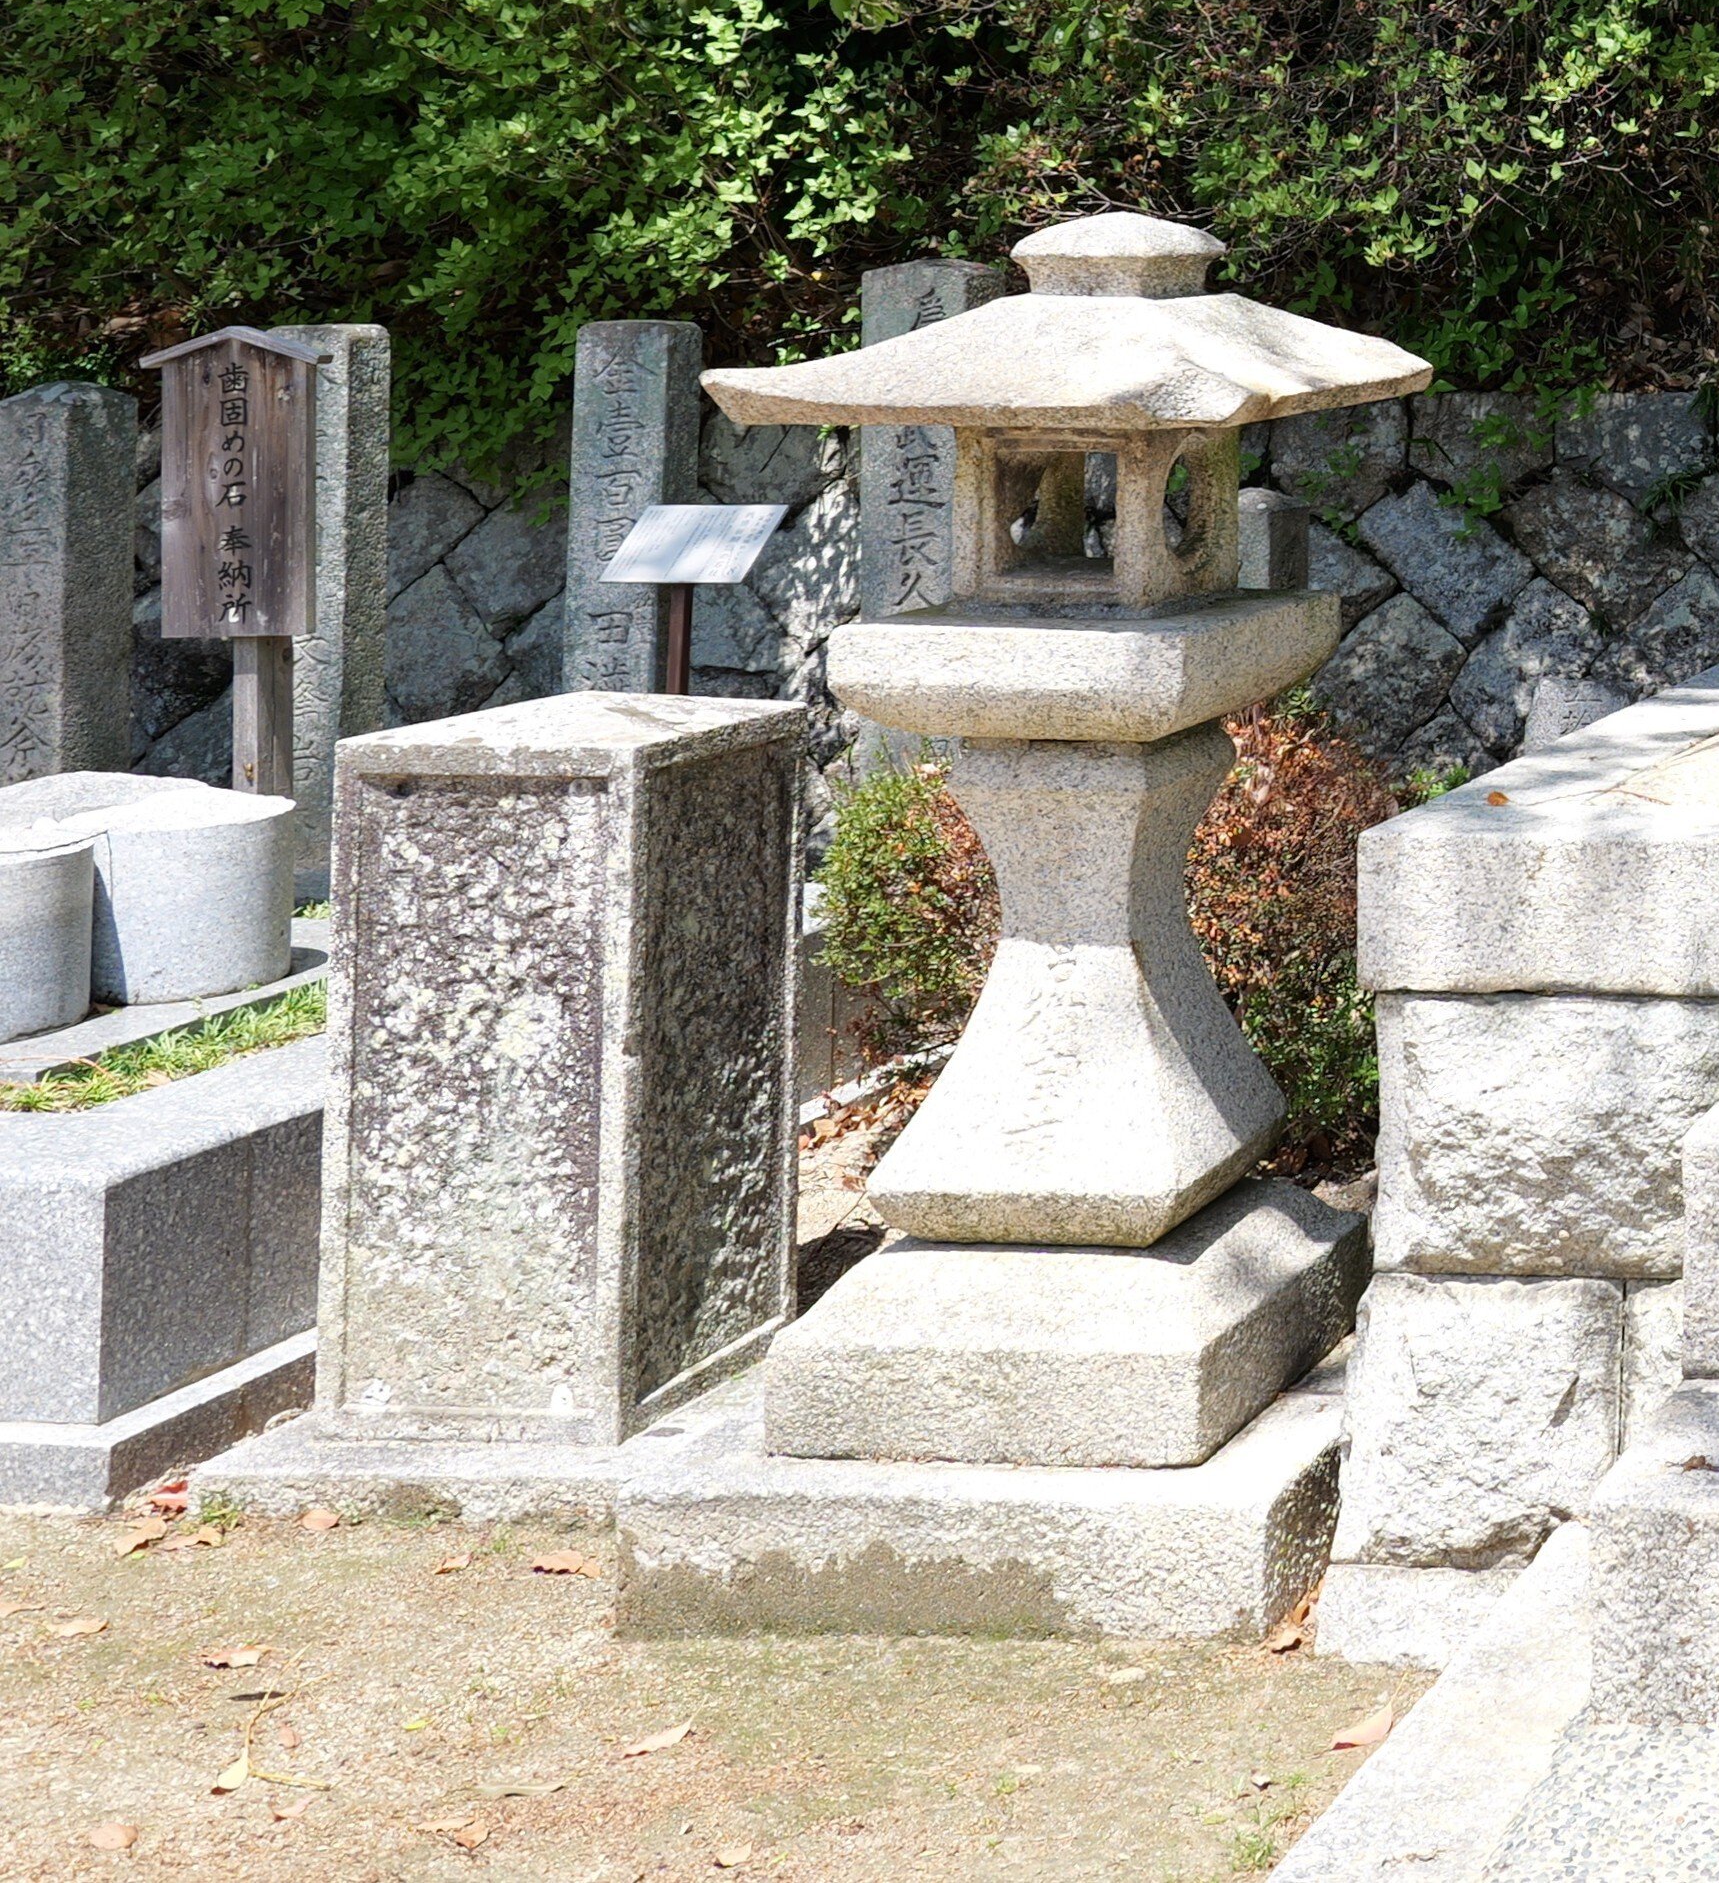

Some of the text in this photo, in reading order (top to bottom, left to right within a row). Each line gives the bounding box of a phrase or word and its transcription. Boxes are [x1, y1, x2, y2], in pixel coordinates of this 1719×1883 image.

[215, 363, 253, 625] 歯固めの石 奉納所
